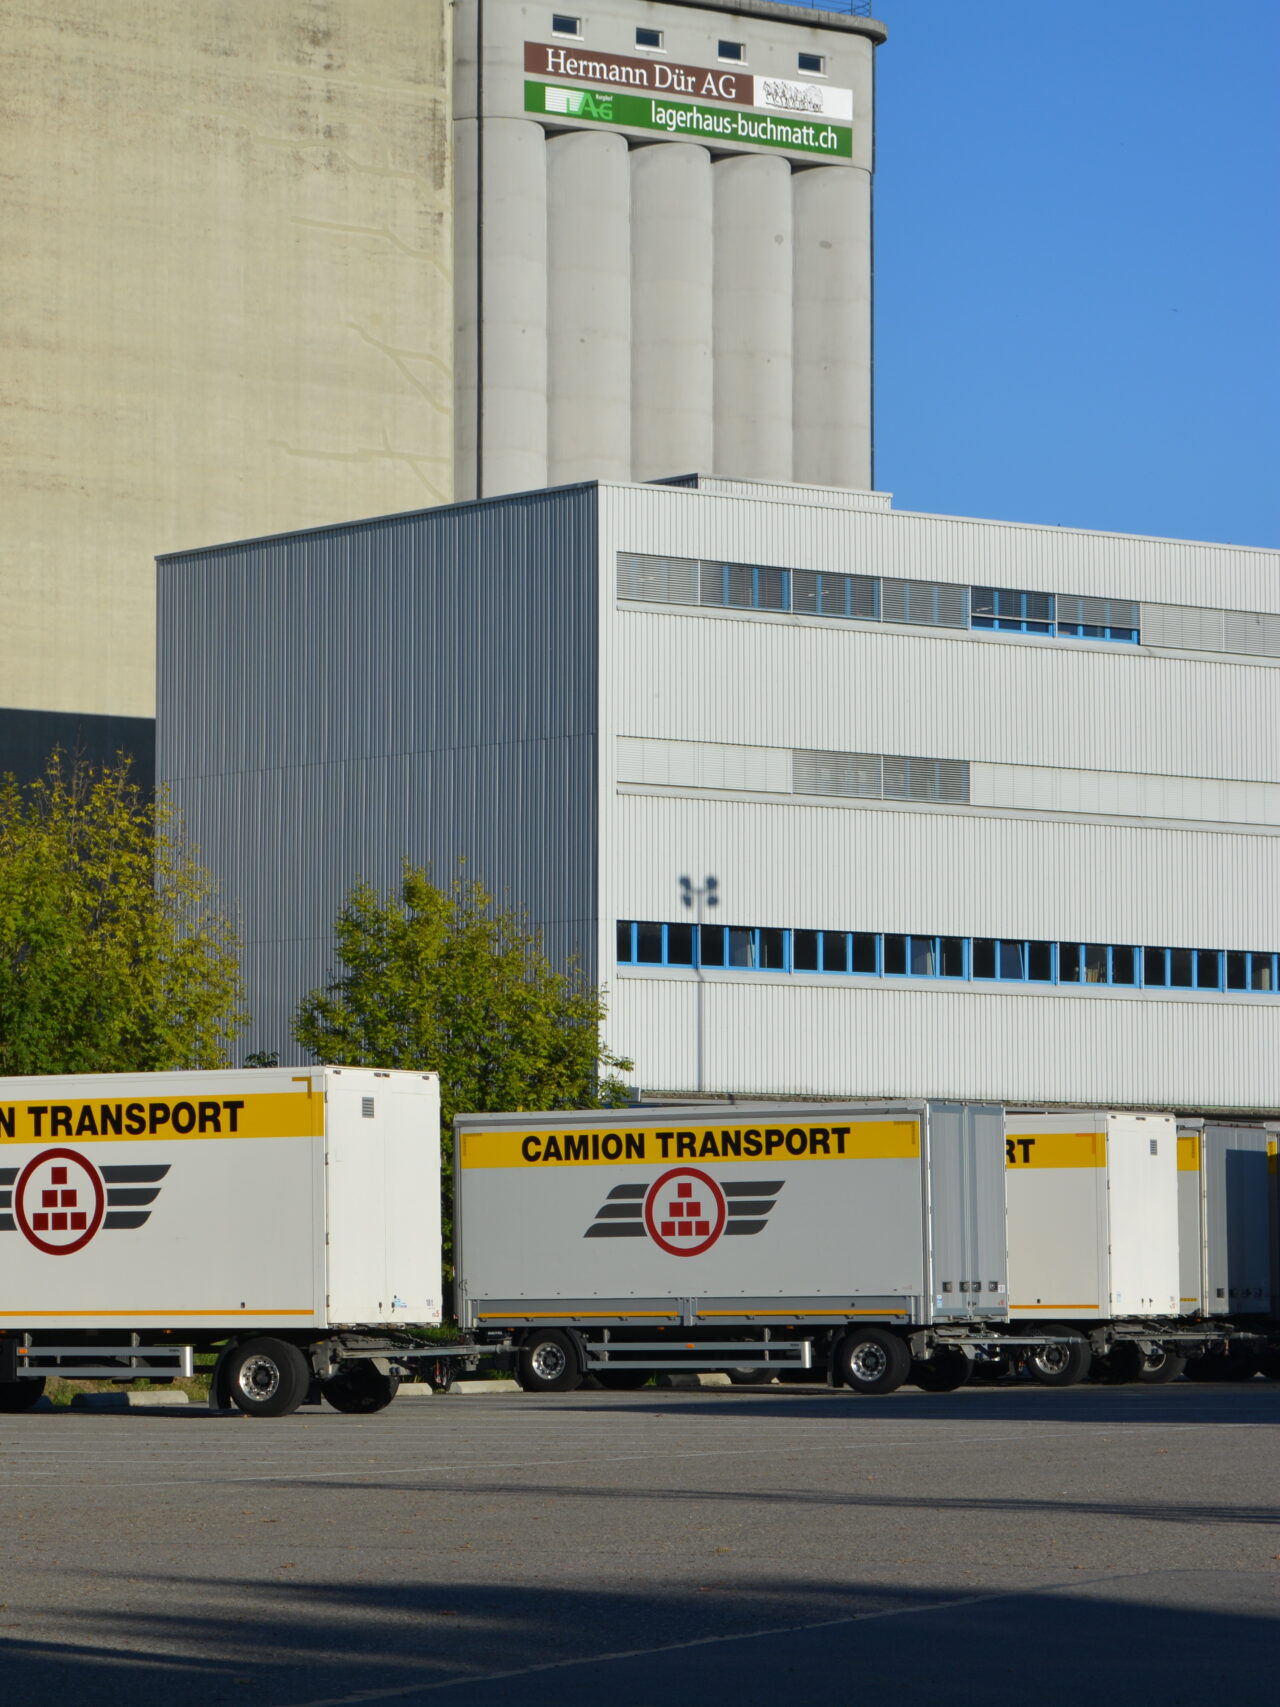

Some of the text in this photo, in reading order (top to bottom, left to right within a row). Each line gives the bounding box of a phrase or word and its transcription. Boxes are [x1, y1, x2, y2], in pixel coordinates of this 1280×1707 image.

[545, 48, 737, 99] Hermann Dür AG
[651, 100, 838, 150] lagerhaus-buchmatt.ch
[27, 1100, 245, 1137] TRANSPORT
[521, 1127, 851, 1162] CAMION TRANSPORT
